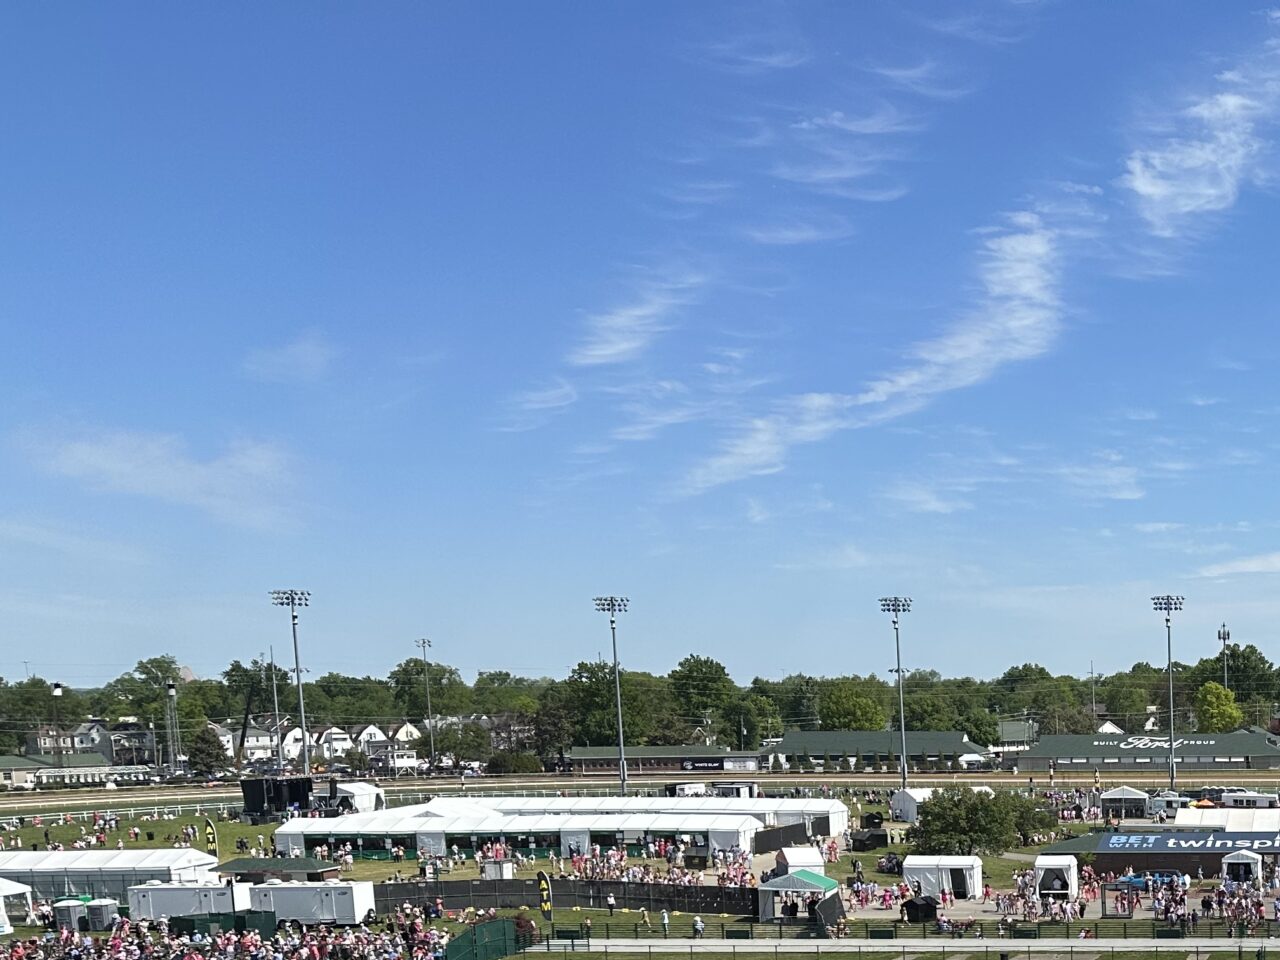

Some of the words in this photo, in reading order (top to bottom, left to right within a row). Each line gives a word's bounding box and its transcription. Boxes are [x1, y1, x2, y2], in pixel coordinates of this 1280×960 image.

[1120, 736, 1184, 749] Ford
[206, 826, 216, 850] ATM
[540, 880, 551, 911] ATM
